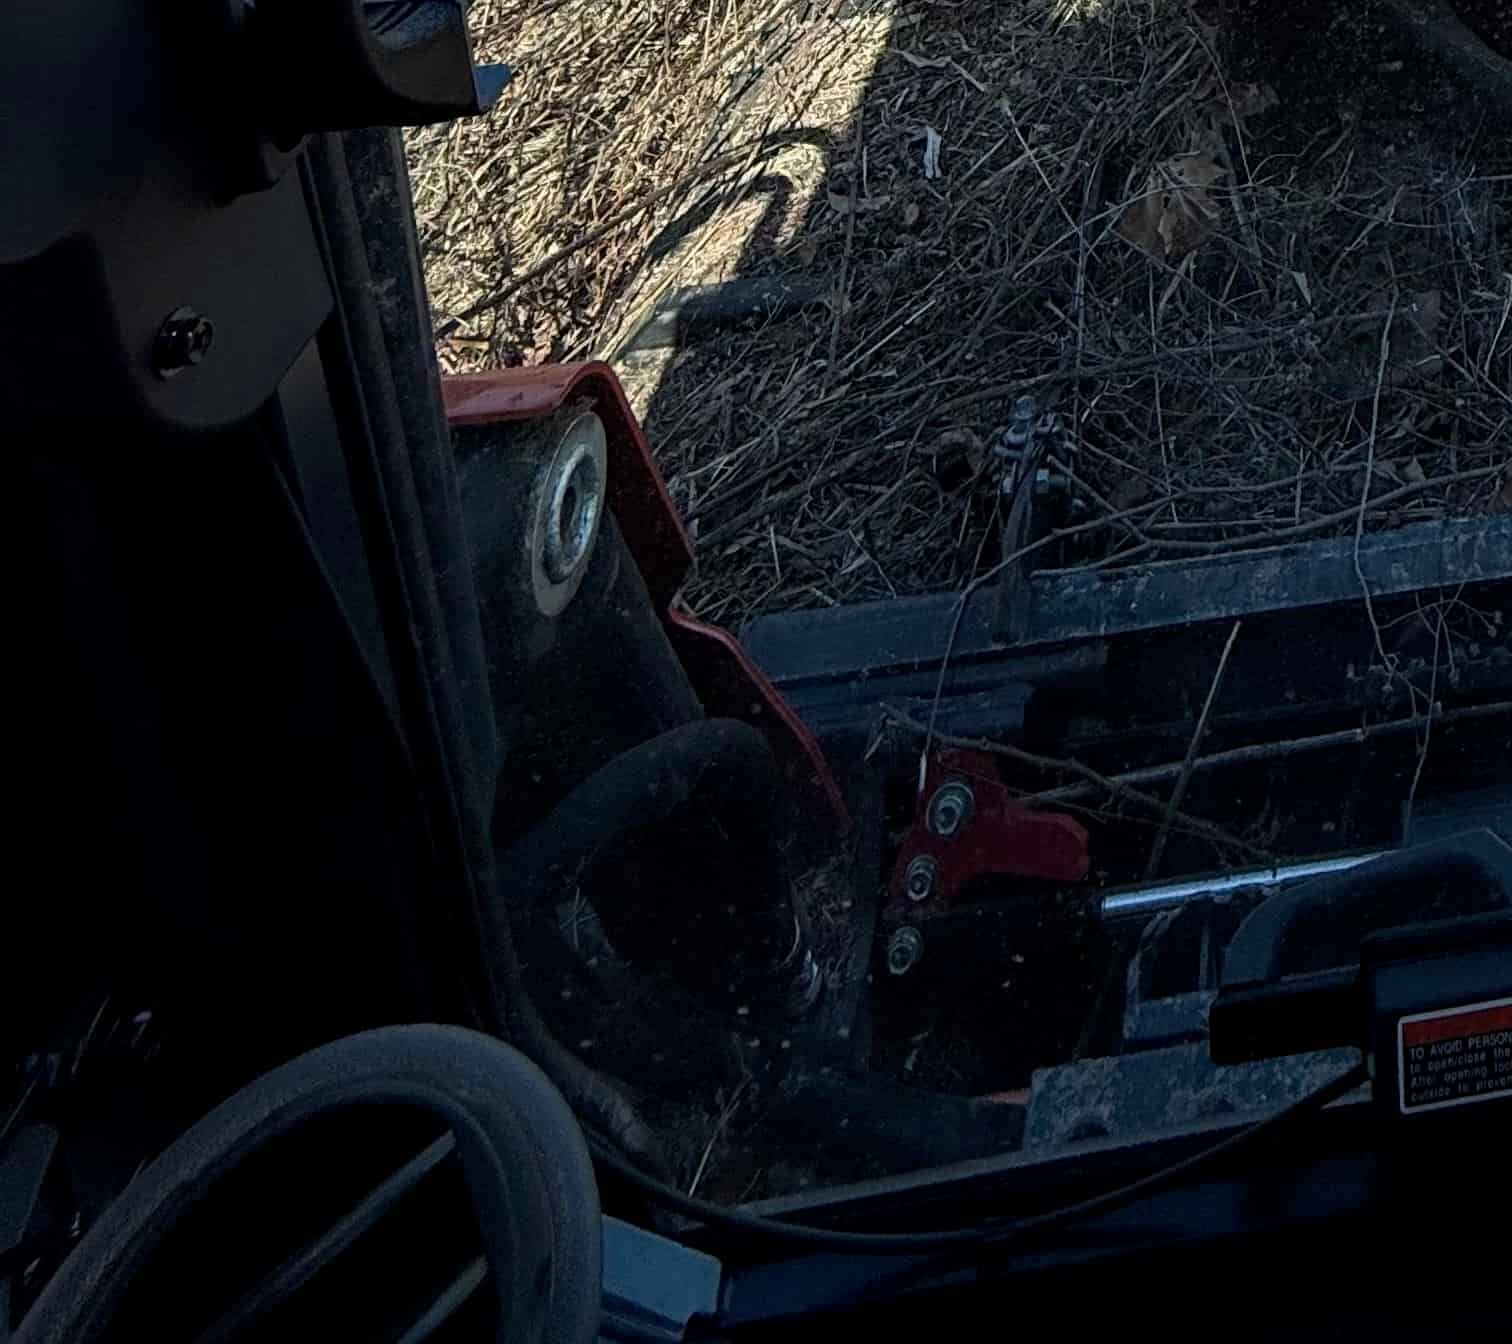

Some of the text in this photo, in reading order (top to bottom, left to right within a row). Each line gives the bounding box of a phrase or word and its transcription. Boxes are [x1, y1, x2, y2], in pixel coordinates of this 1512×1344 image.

[1410, 1046, 1424, 1060] TO
[1430, 1039, 1462, 1056] AVOID
[1410, 1062, 1422, 1074] to
[1427, 1051, 1487, 1073] open/close
[1493, 1046, 1510, 1059] the
